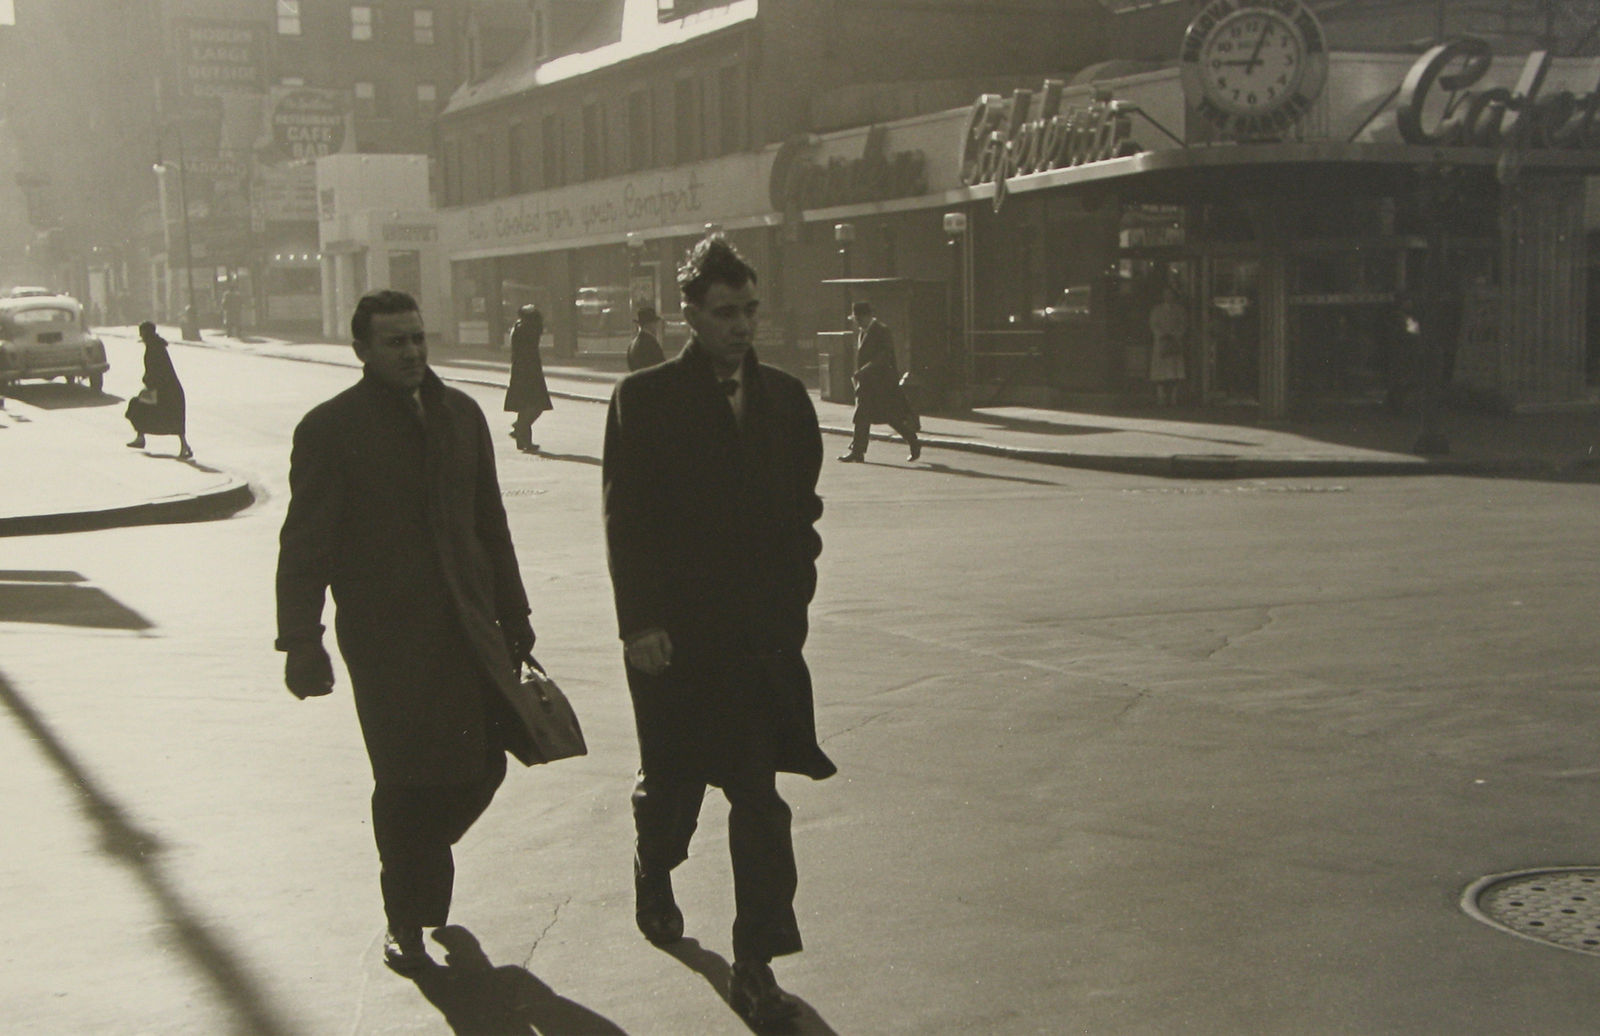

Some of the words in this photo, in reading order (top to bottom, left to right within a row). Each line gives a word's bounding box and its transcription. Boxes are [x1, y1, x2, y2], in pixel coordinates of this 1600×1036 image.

[1183, 1, 1233, 63] BULOVA
[192, 46, 249, 63] LARGE
[188, 64, 257, 81] OUTSIDE
[1247, 92, 1257, 104] 6
[286, 126, 332, 142] CAFE
[292, 142, 329, 158] BAR
[492, 197, 540, 238] Cooled
[544, 197, 574, 238] for
[579, 200, 619, 233] your
[622, 170, 705, 225] Comfort
